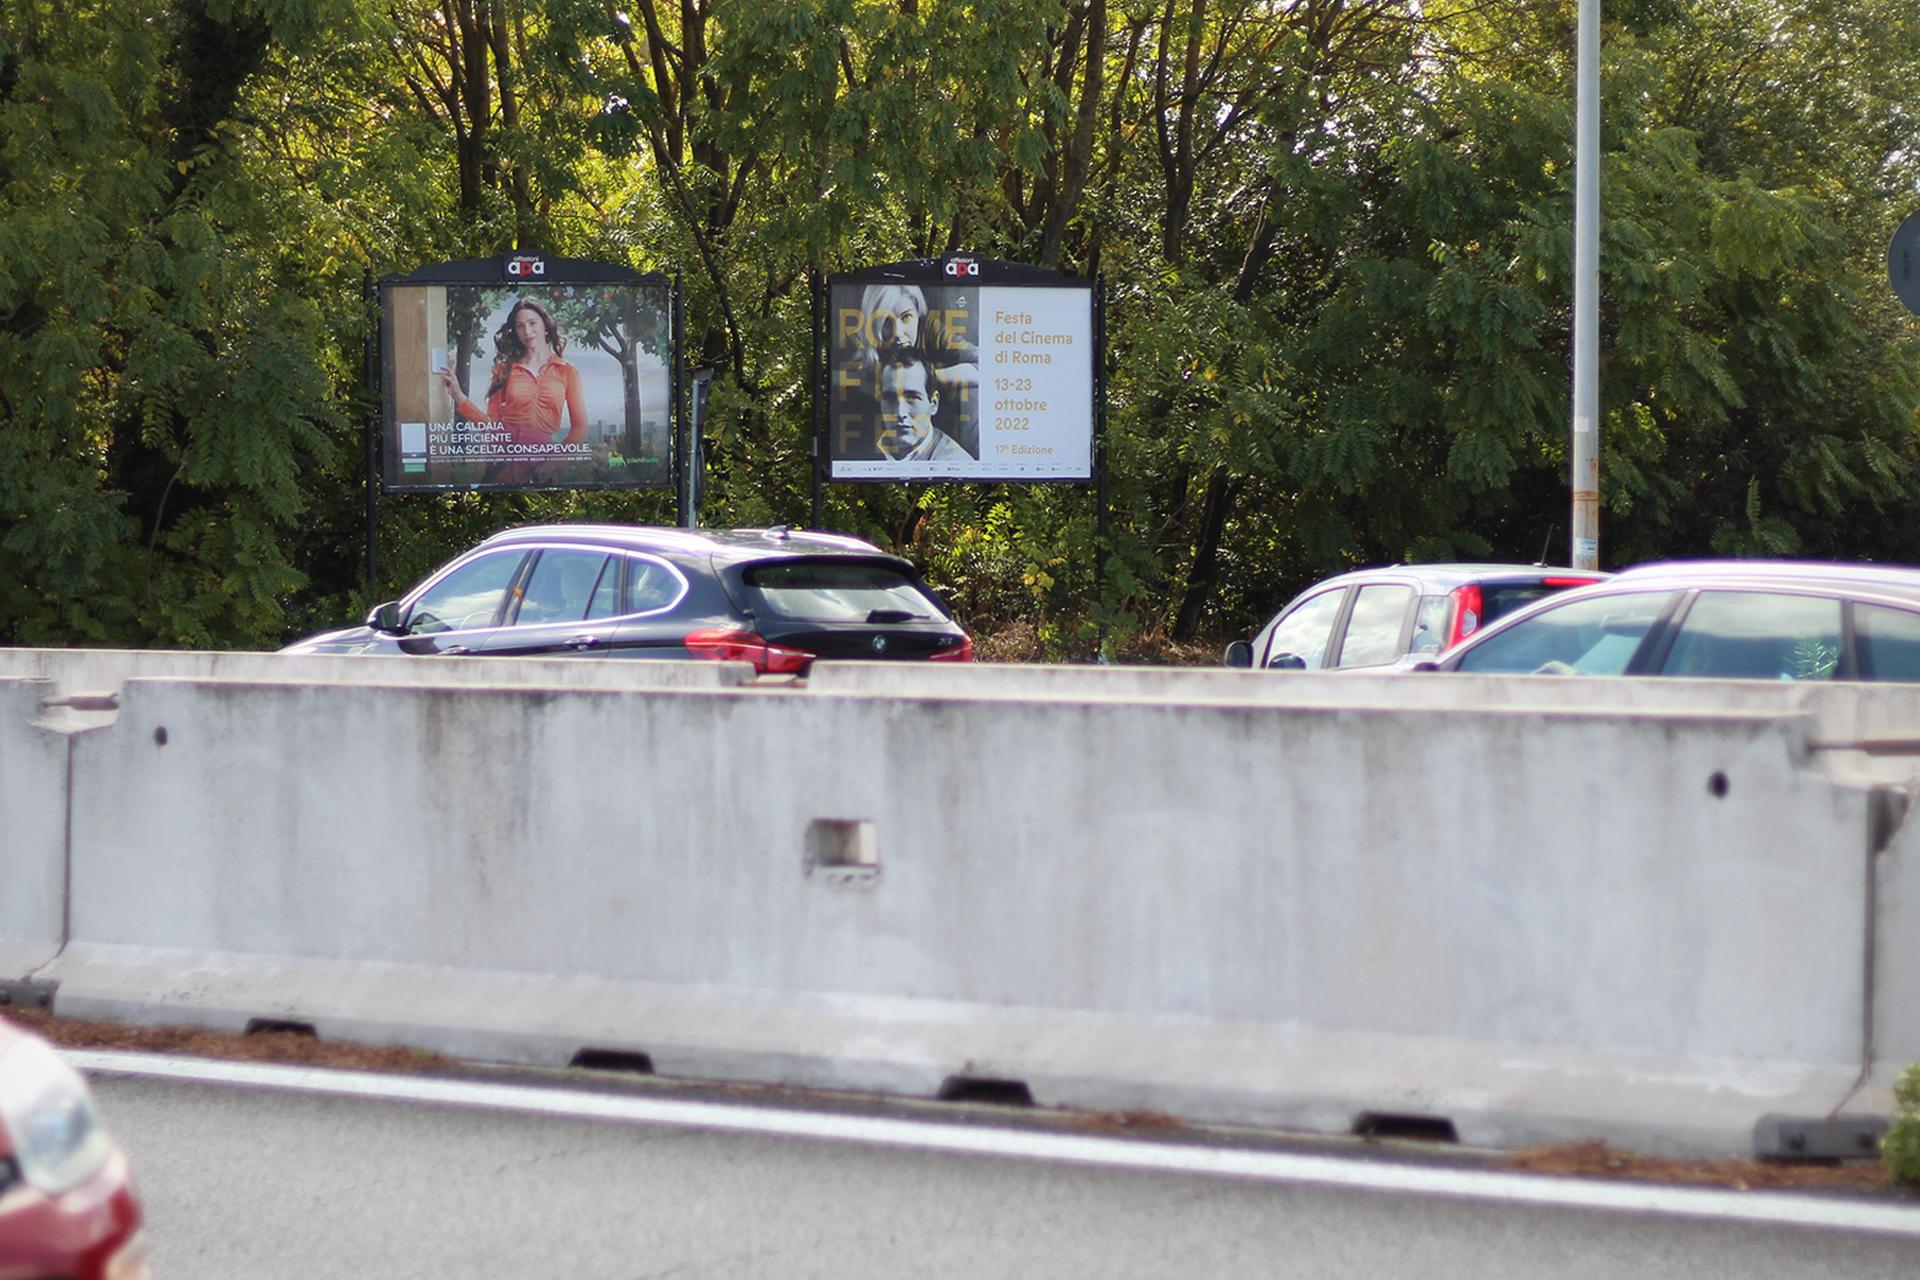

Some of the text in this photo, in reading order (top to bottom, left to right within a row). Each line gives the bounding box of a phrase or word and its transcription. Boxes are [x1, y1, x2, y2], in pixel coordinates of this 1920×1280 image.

[508, 261, 545, 277] apa
[945, 262, 979, 278] apa
[995, 311, 1032, 324] Festa
[839, 309, 969, 349] ROME
[995, 331, 1073, 345] del Cinema
[995, 351, 1052, 364] di Roma
[994, 378, 1032, 391] 13-23
[994, 398, 1048, 411] ottobre
[429, 422, 505, 431] UNA CALDAIA
[995, 417, 1030, 430] 2022
[452, 433, 512, 443] EFFICIENTE
[440, 445, 464, 454] UNA
[465, 444, 505, 454] SCELTA
[507, 443, 593, 454] CONSAPEVOLE.
[1012, 445, 1053, 455] Edizione
